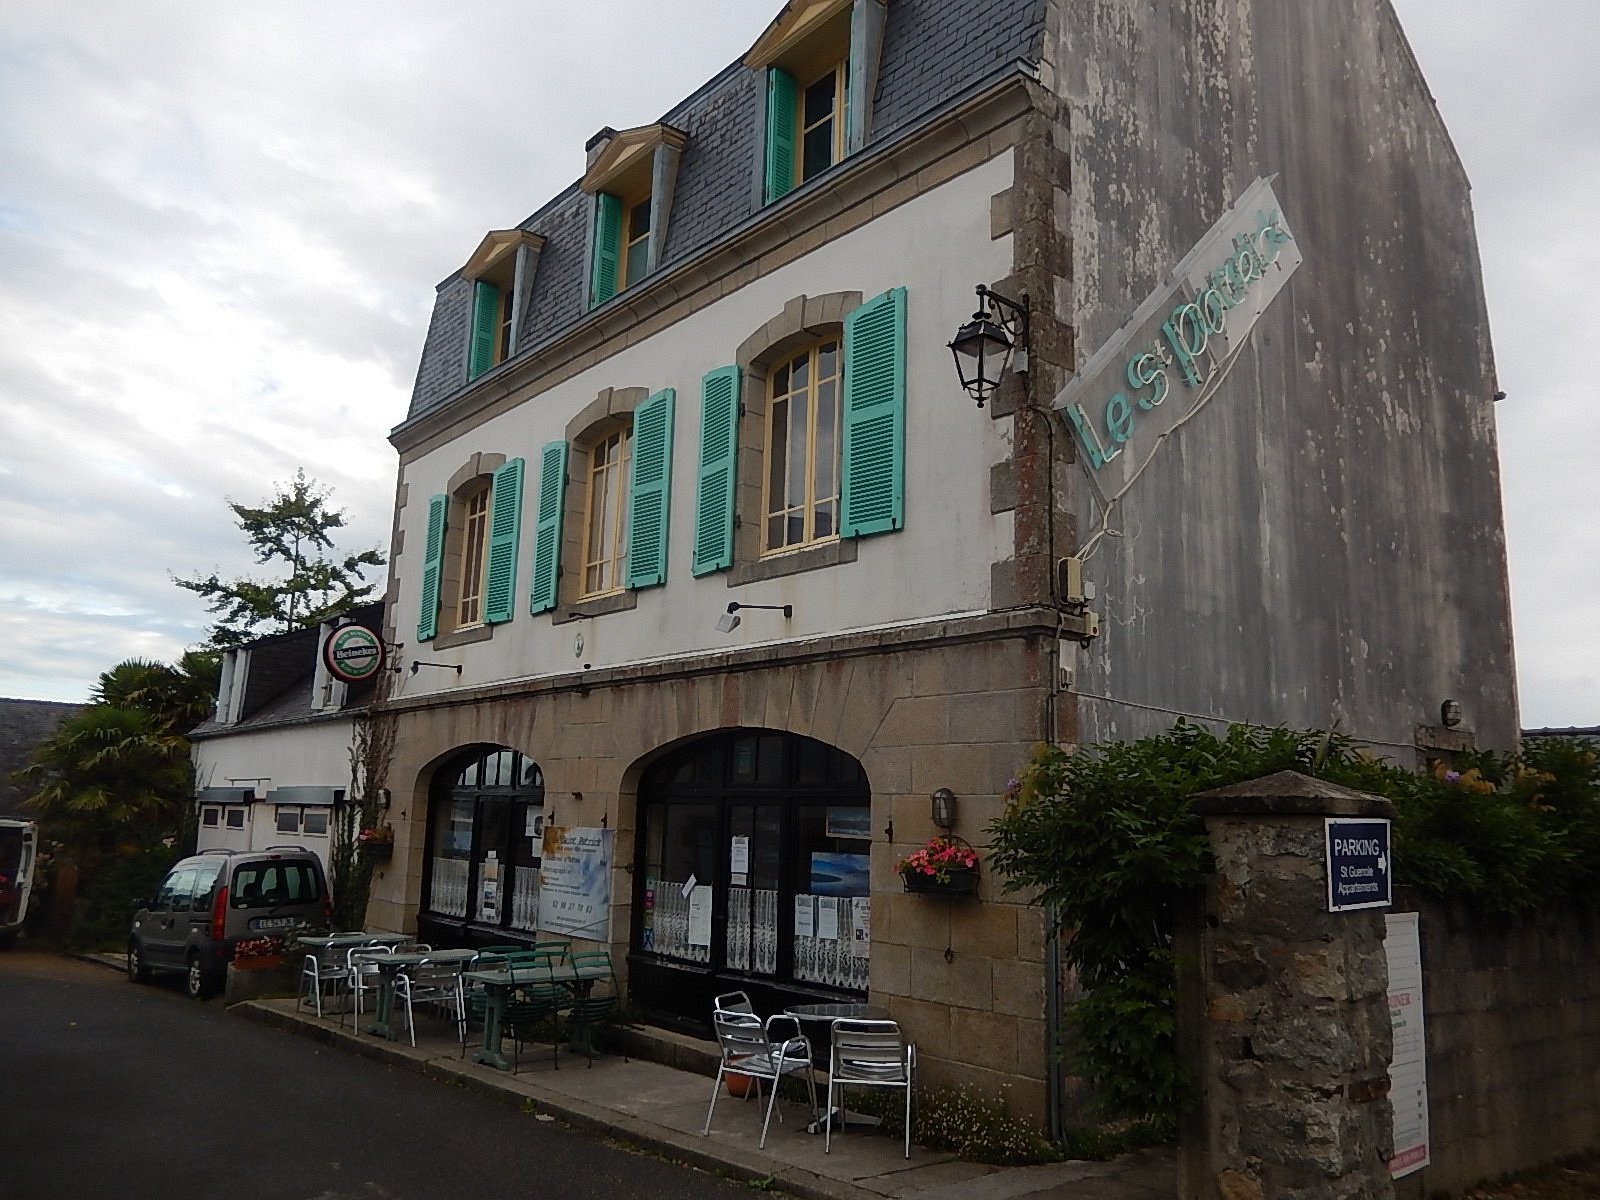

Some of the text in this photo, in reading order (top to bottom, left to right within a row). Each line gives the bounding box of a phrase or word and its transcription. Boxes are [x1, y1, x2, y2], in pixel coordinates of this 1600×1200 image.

[1066, 393, 1135, 470] Le
[336, 648, 377, 658] Heineken
[1334, 838, 1380, 856] PARKING
